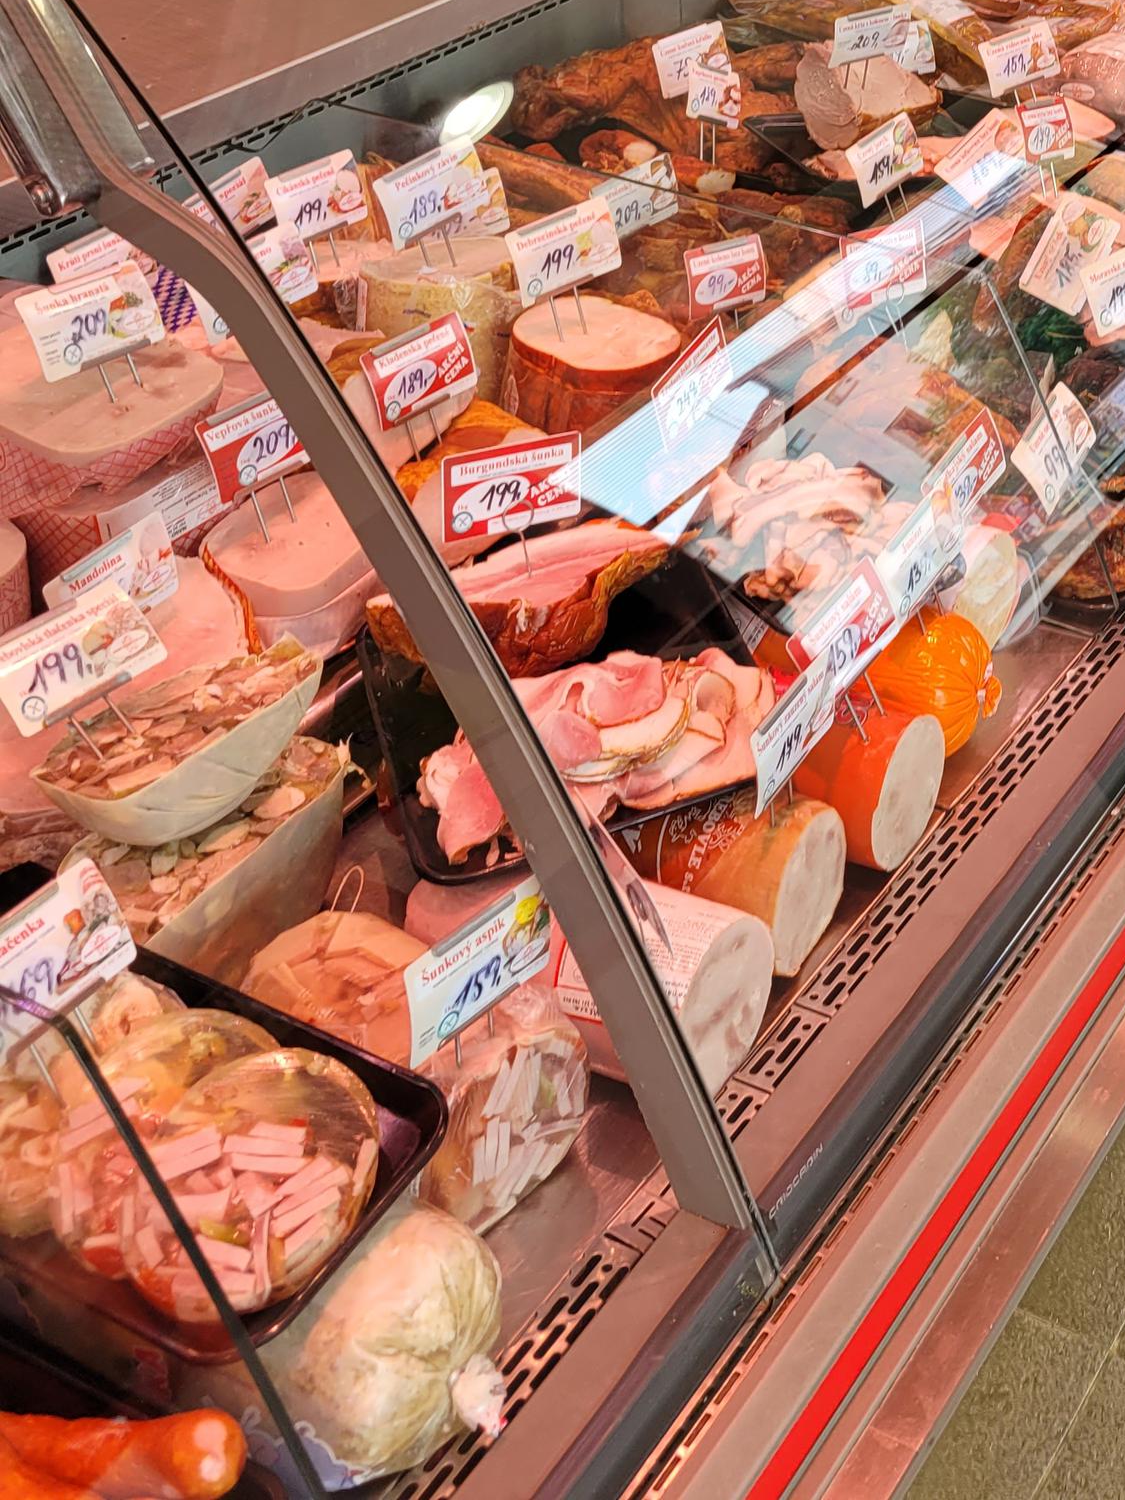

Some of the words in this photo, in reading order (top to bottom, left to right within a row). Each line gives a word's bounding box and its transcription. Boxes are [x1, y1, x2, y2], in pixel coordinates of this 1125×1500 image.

[444, 355, 469, 385] CENA
[460, 454, 528, 477] Burgundská
[531, 446, 564, 462] šunka
[421, 941, 473, 988] Šunkový
